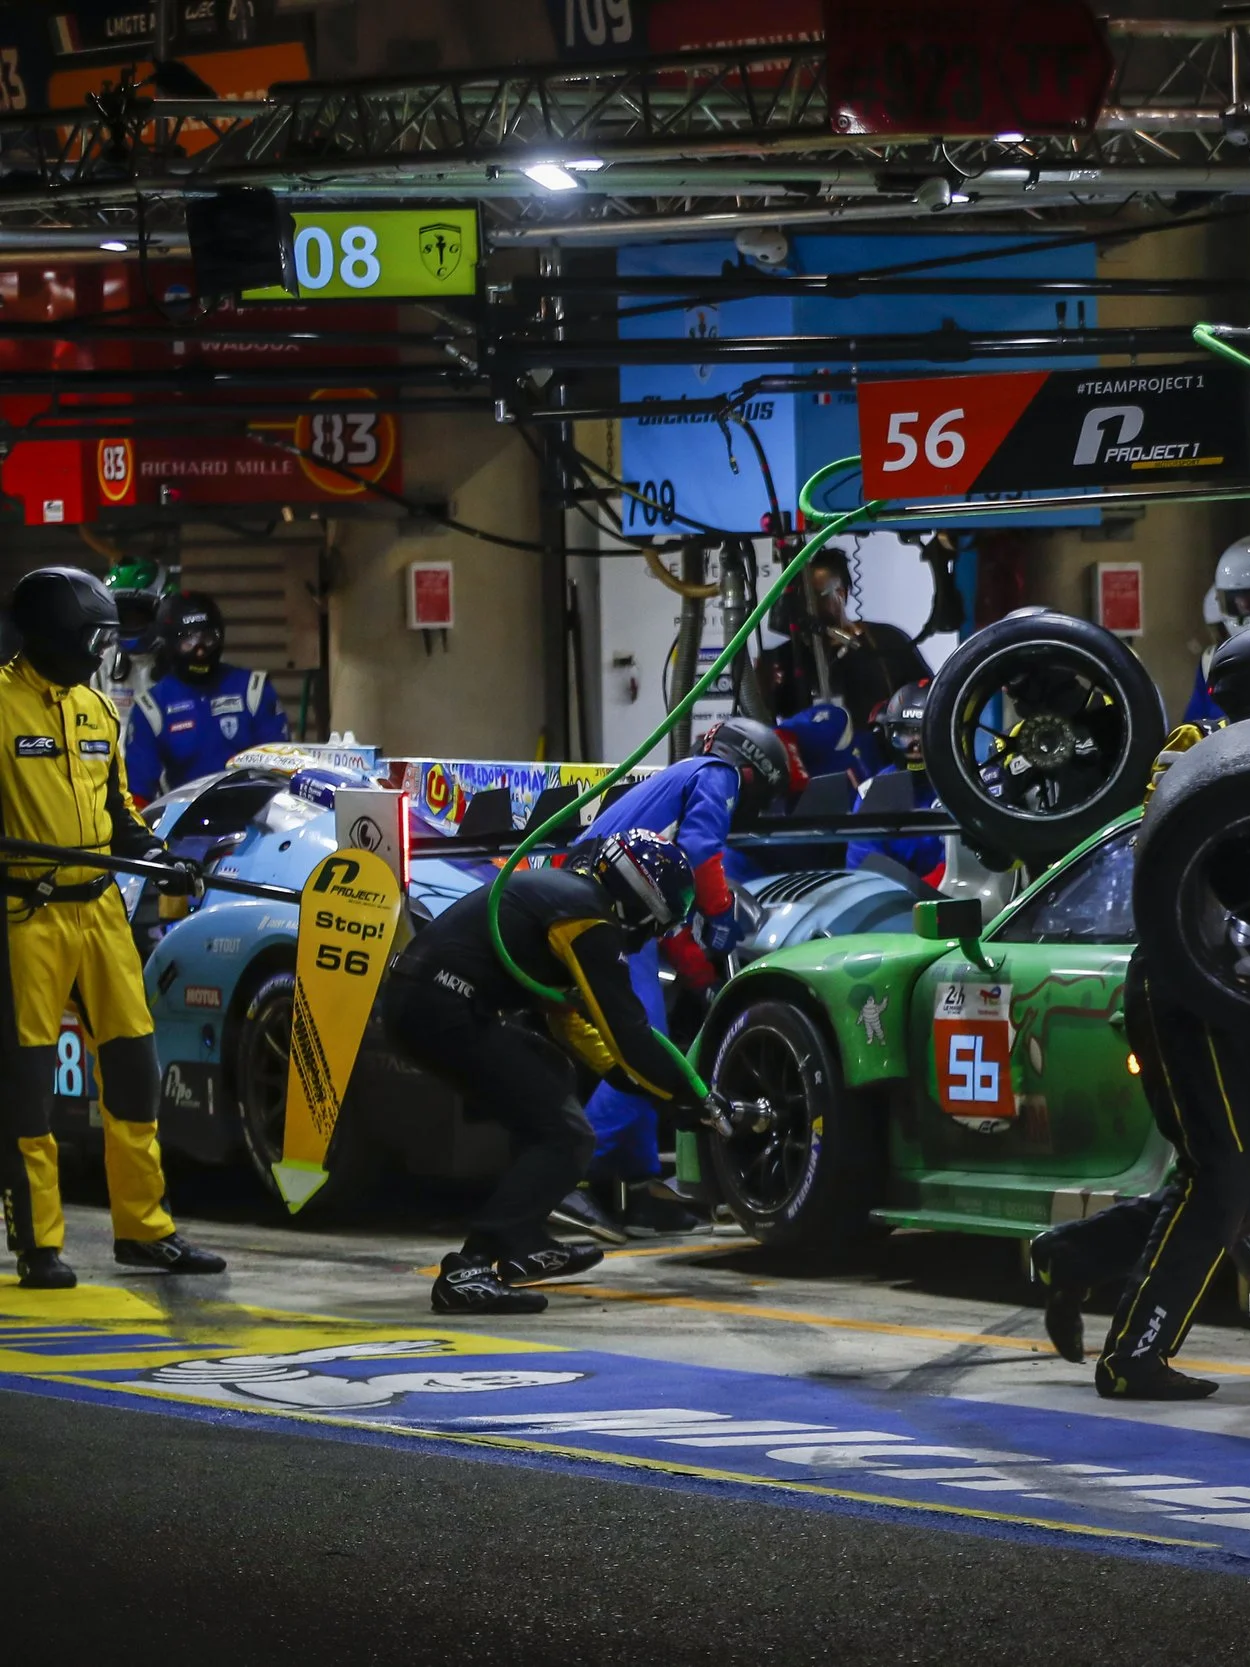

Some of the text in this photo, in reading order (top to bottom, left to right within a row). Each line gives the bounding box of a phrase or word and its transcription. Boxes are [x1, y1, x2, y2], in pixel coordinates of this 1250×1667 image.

[106, 14, 146, 36] LMGTE
[293, 225, 381, 289] 08
[1077, 376, 1205, 395] #TEAMPROJECT 1
[311, 414, 378, 465] 83
[882, 408, 966, 472] 56
[1104, 443, 1201, 464] PROJECT 1
[104, 447, 126, 481] 83
[141, 459, 293, 477] RICHARD MILLE
[622, 480, 675, 527] 709
[902, 709, 924, 719] uve
[741, 738, 782, 784] uvex
[330, 885, 380, 902] PROJECT
[315, 911, 385, 941] Stop!
[315, 944, 371, 977] 56
[186, 987, 220, 1005] MOTUL
[433, 969, 475, 999] MRTC
[54, 1030, 84, 1097] 8
[787, 1149, 819, 1220] MICHELIN
[1131, 1305, 1167, 1358] HRX
